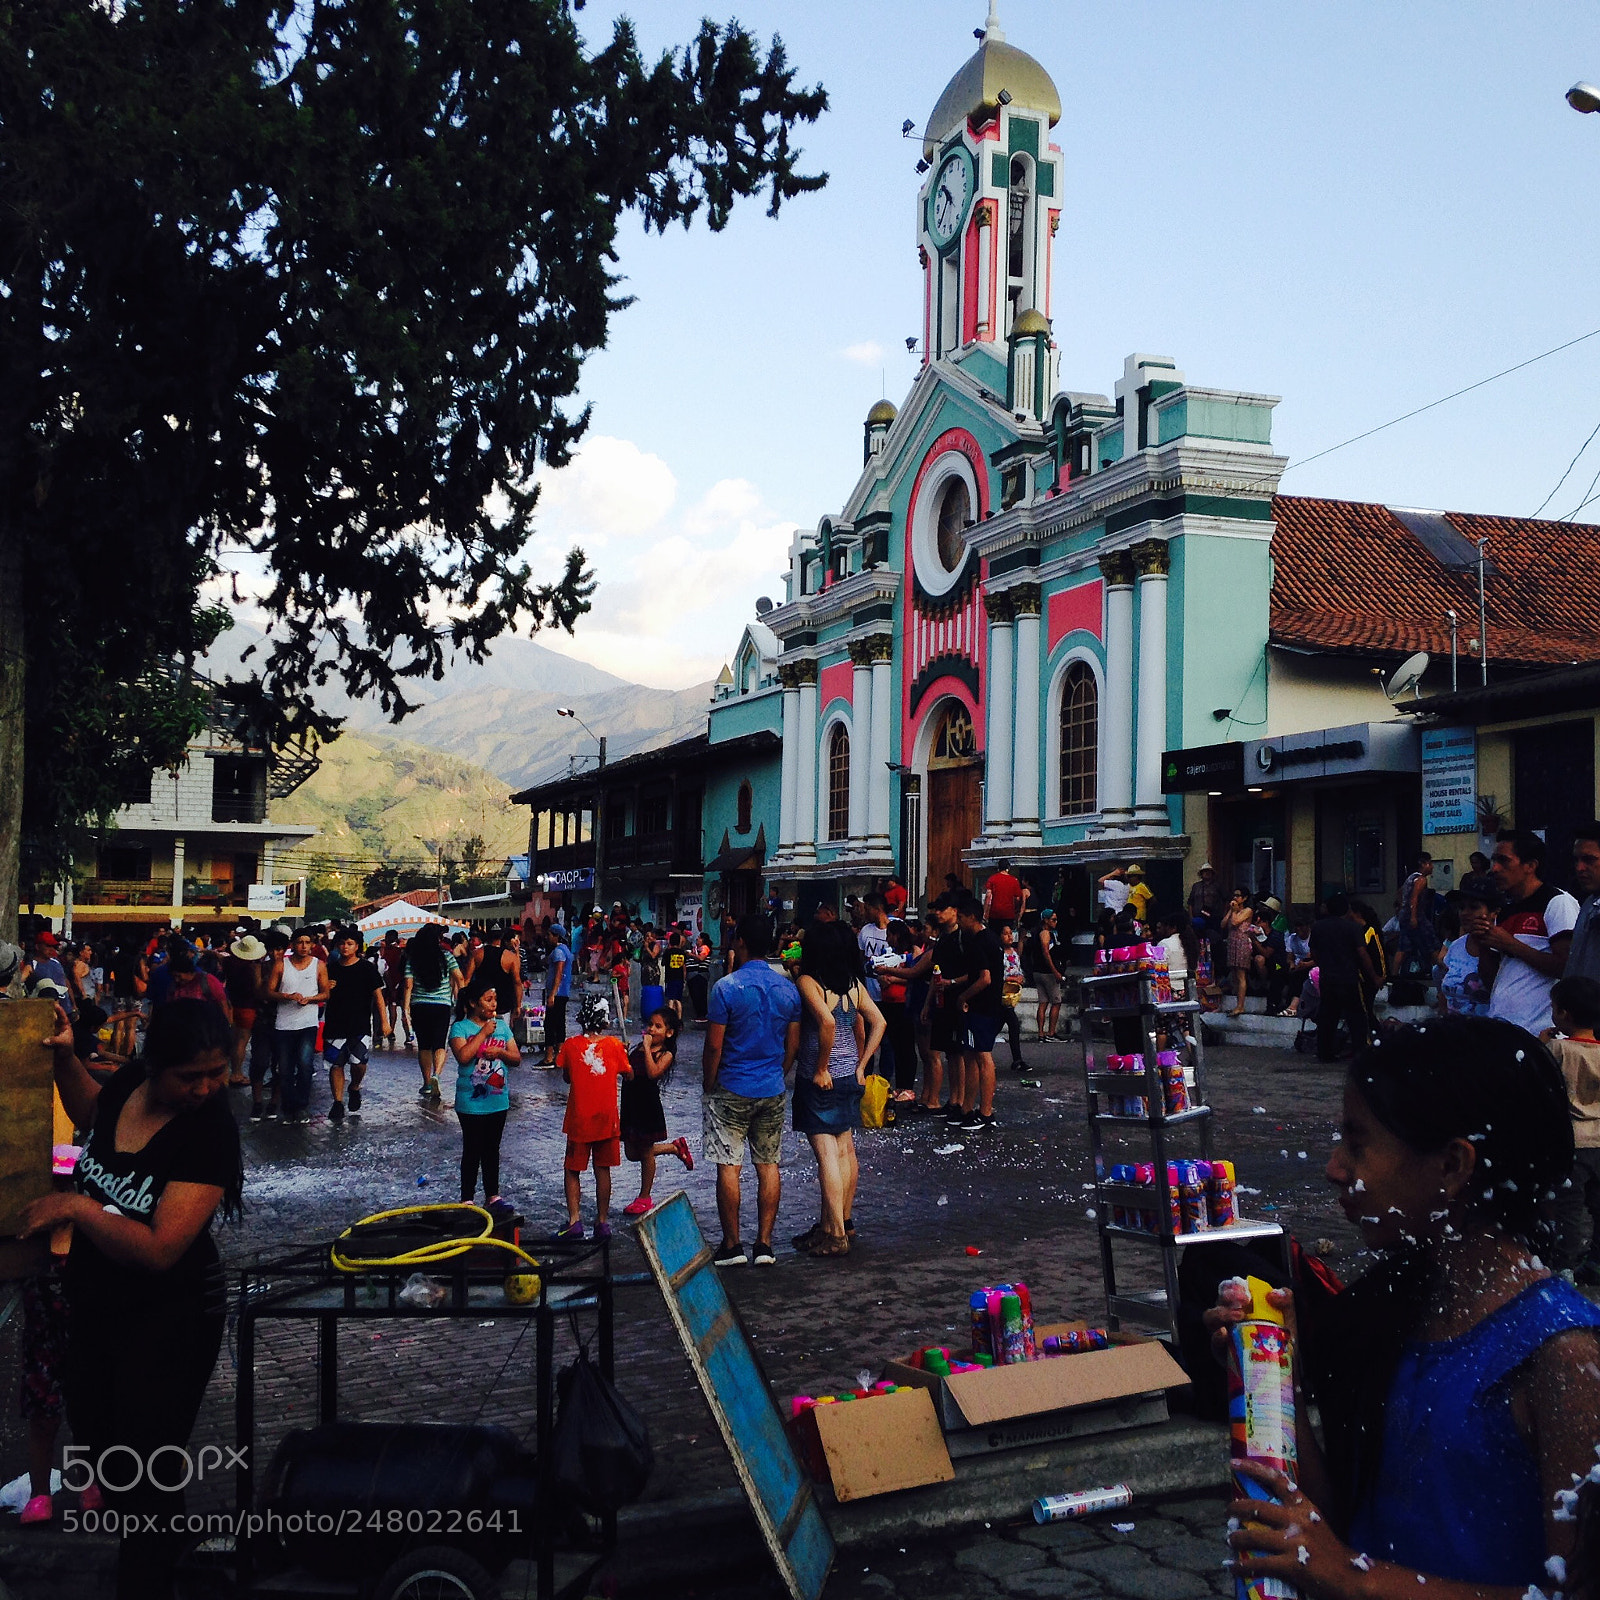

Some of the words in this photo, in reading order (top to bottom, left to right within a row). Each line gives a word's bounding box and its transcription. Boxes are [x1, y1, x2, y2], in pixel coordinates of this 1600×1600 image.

[1430, 789, 1447, 798] HOUSE
[1449, 787, 1471, 796] RENTALS
[1430, 800, 1444, 808] LAND
[1445, 798, 1461, 807] SALES
[1430, 810, 1446, 819] HOME
[1446, 809, 1462, 817] SALES
